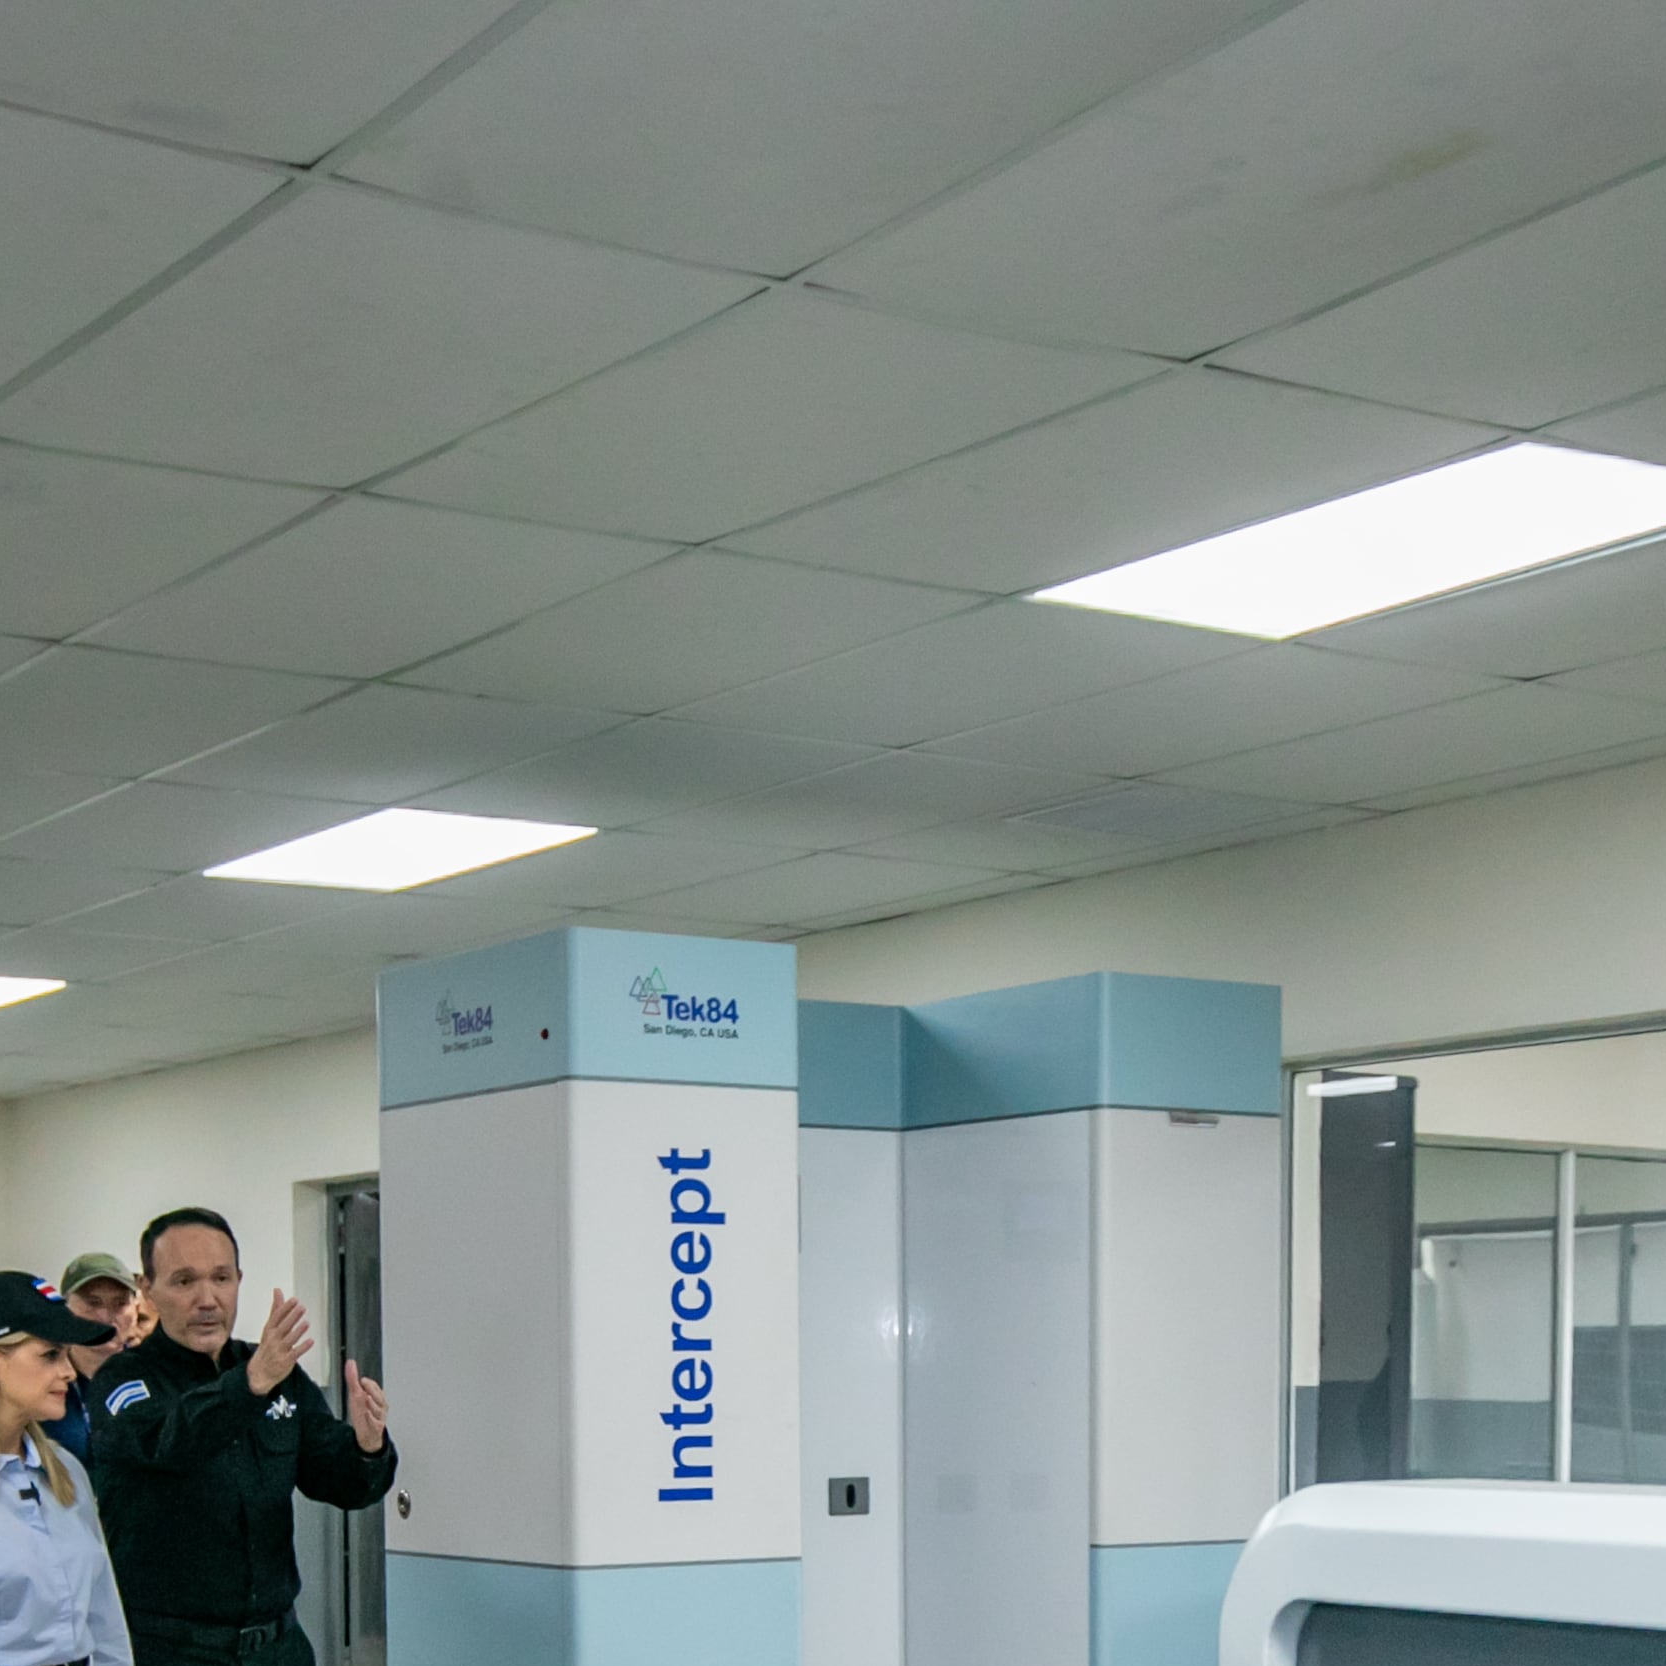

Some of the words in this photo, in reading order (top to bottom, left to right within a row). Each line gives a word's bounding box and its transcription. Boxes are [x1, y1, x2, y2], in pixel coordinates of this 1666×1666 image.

[451, 1005, 493, 1036] Tek84
[661, 994, 739, 1024] Tek84
[643, 1023, 663, 1034] San
[699, 1027, 714, 1037] CA
[717, 1028, 739, 1039] USA
[657, 1147, 726, 1502] Intercept
